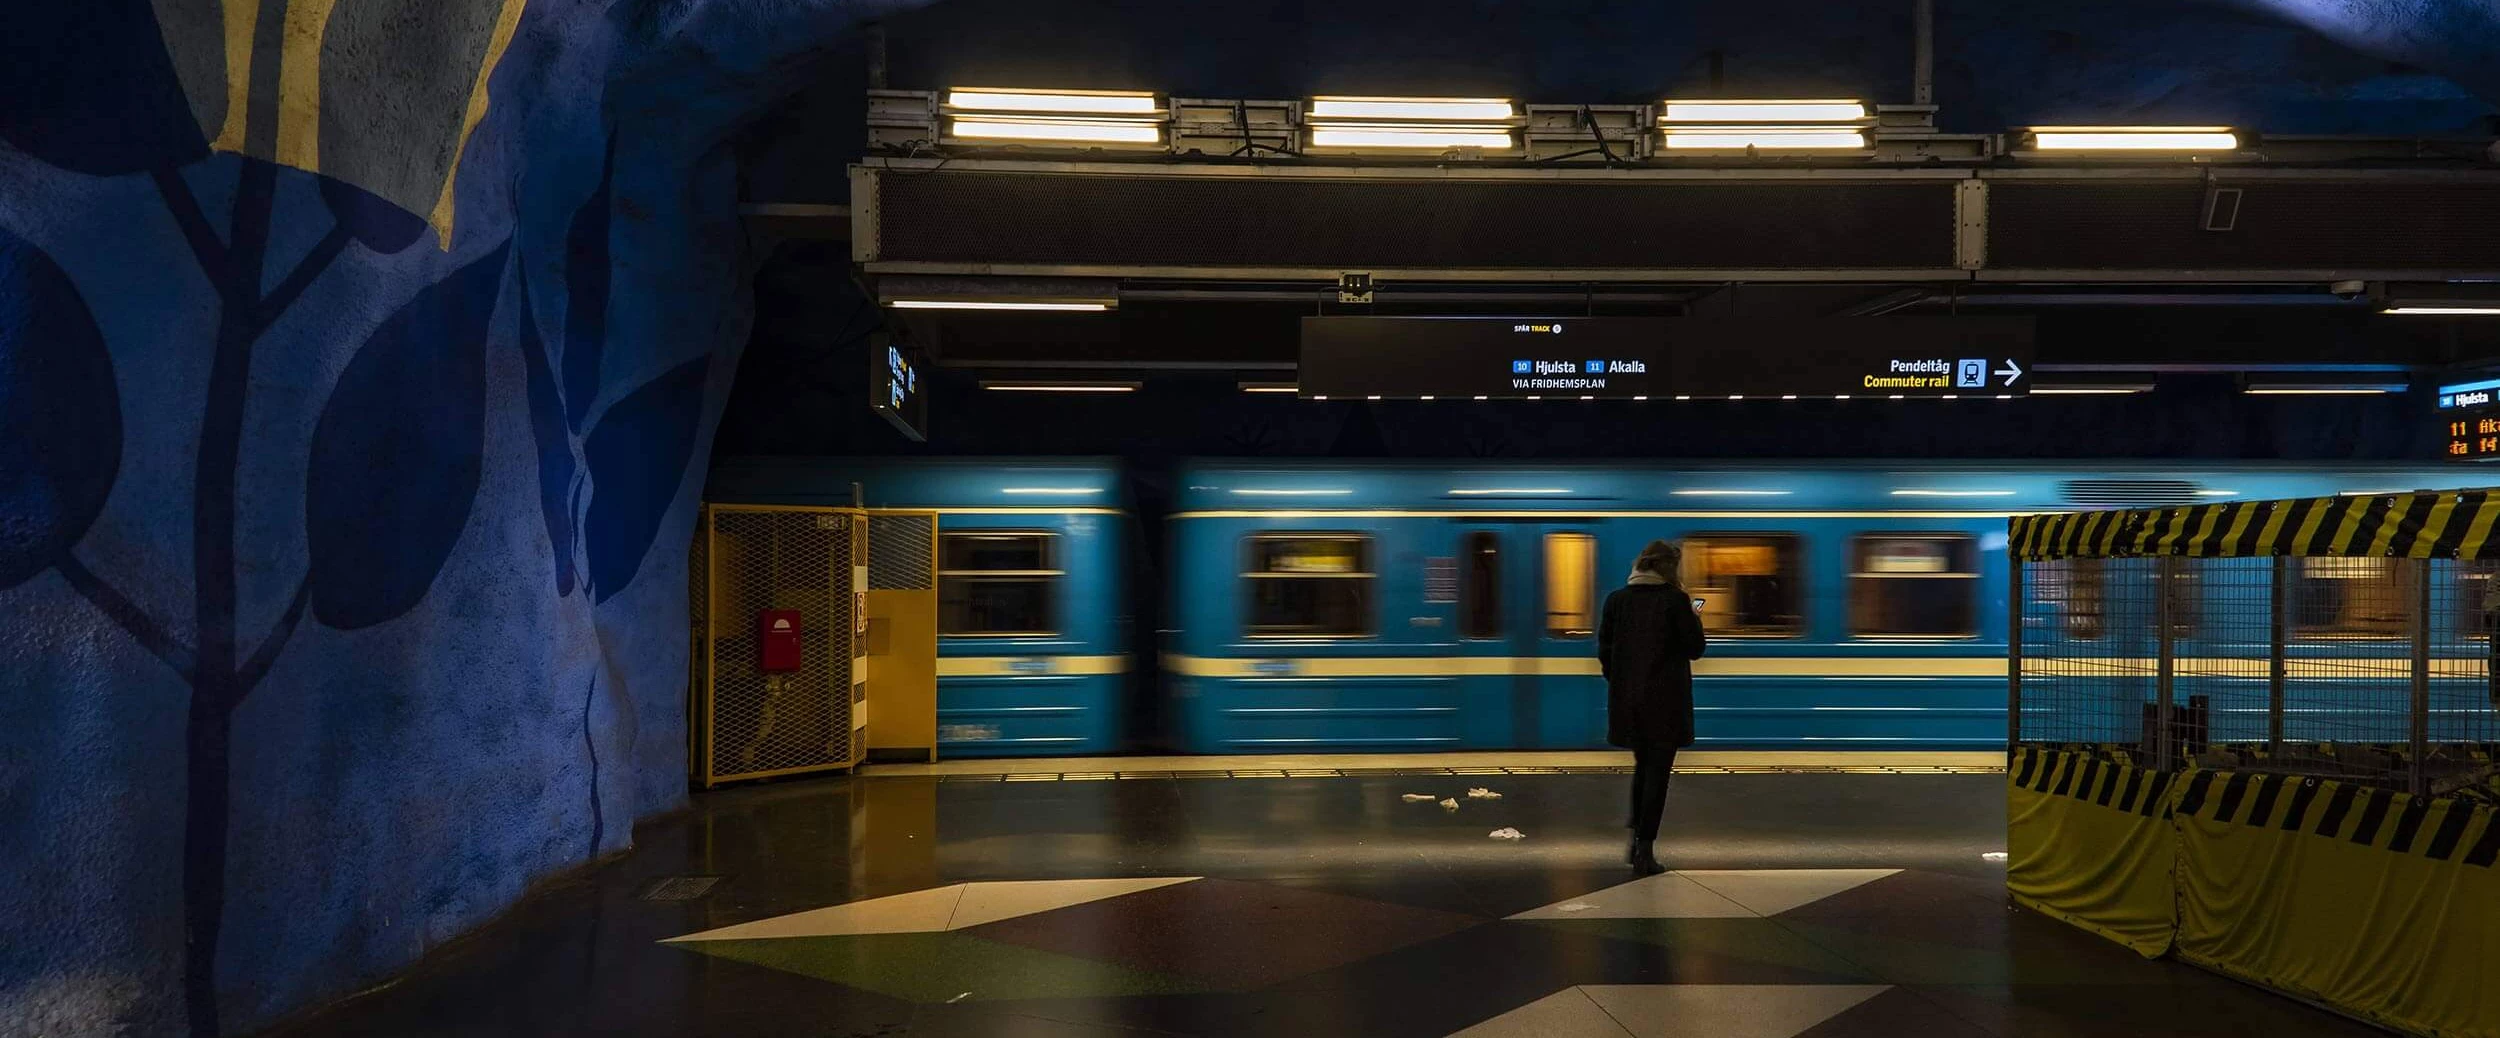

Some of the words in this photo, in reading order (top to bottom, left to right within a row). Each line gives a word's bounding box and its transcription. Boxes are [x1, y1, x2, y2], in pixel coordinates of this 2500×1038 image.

[1531, 325, 1551, 333] TRACK
[1535, 360, 1576, 376] Hjulsta
[1608, 360, 1646, 373] Akalla
[1890, 359, 1950, 374] Pendeltåg
[1512, 379, 1529, 389] VIA
[1531, 379, 1605, 389] FRIDHEMSPLAN
[1864, 375, 1928, 388] Commuter
[1928, 375, 1949, 388] rail
[2456, 392, 2489, 407] Hjulsta
[2450, 421, 2466, 437] 11
